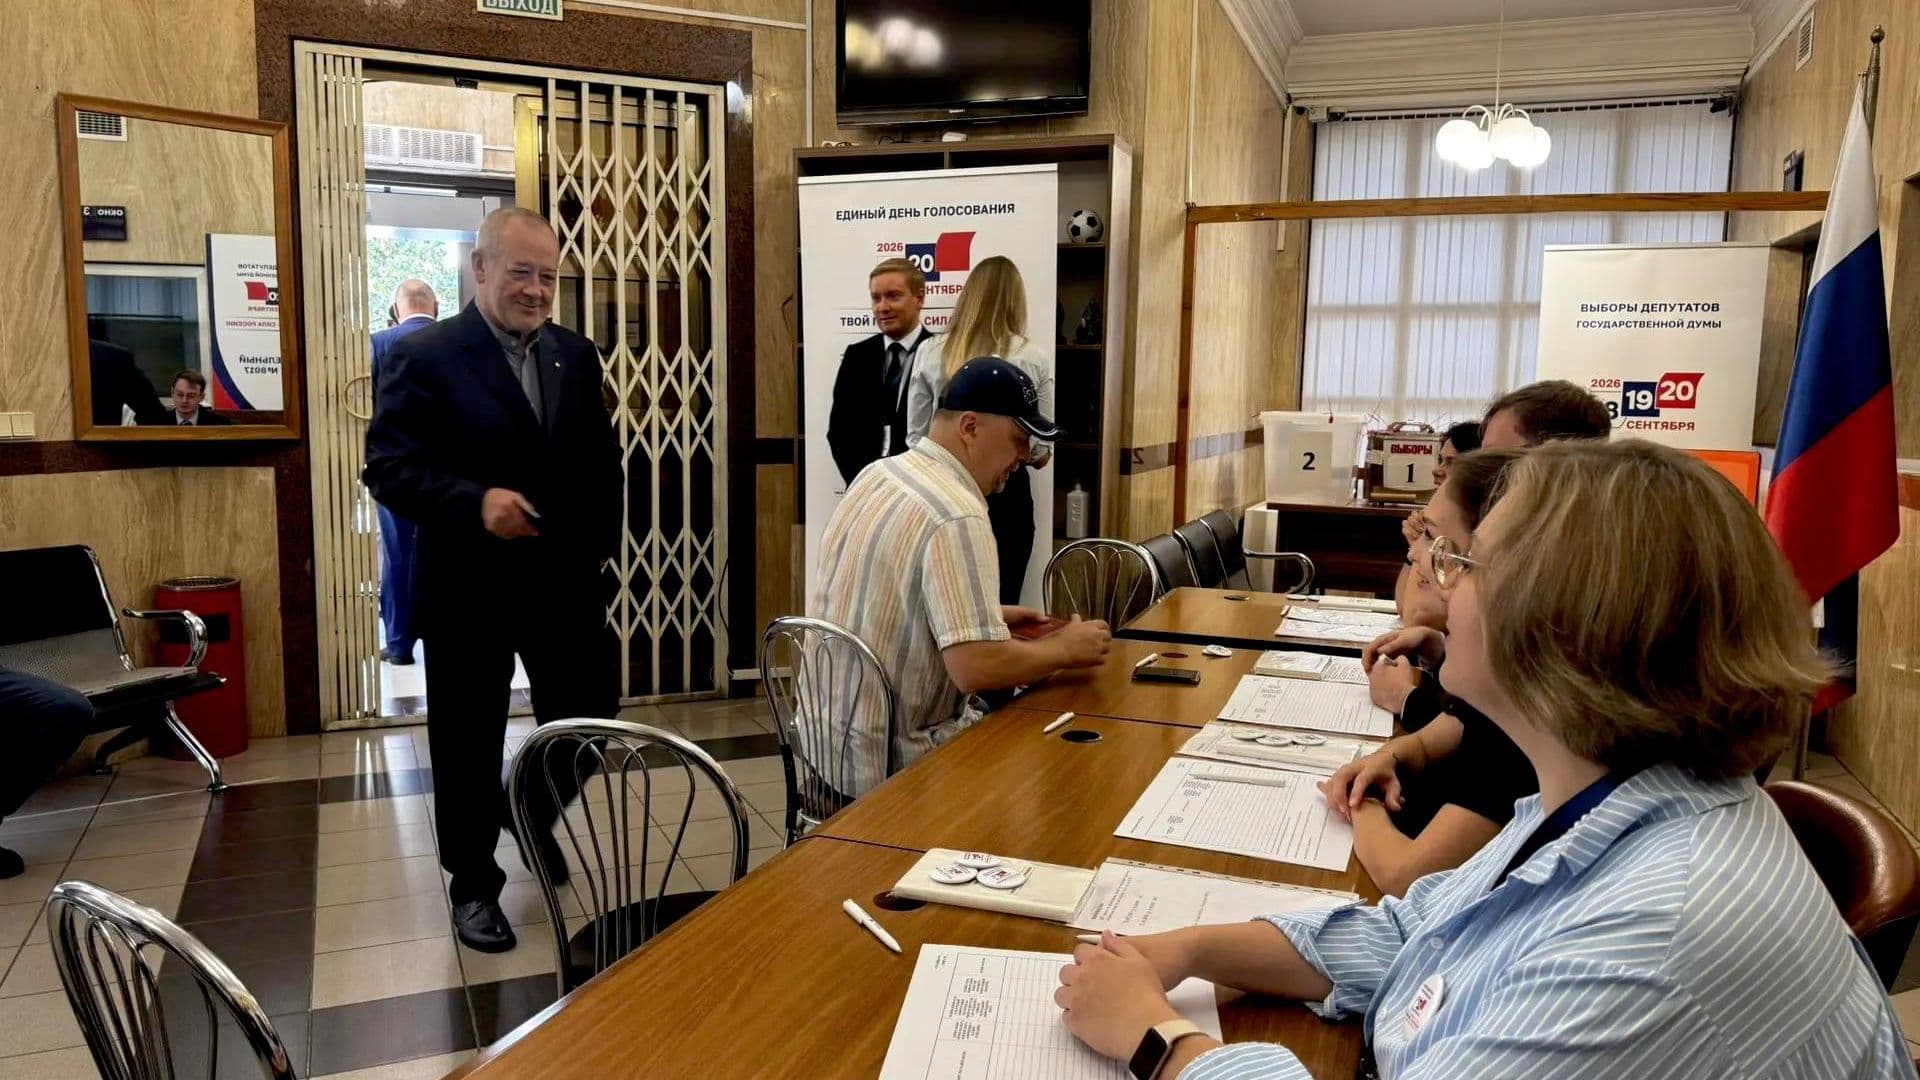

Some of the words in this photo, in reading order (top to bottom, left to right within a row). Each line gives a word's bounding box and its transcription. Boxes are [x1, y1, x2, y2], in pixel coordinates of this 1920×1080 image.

[836, 206, 886, 222] ЕДИНЫЙ
[889, 207, 921, 220] ДЕНЬ
[924, 203, 1015, 218] ГОЛОСОВАНИЯ
[877, 242, 904, 252] 2026
[926, 284, 964, 295] НТЯБР
[1580, 303, 1638, 313] ВЫБОРЫ
[1640, 302, 1720, 314] ДЕПУТАТОВ
[840, 315, 870, 327] ТВОЙ
[1576, 319, 1684, 329] ГОСУДАРСТВЕННОЙ
[1686, 320, 1722, 329] ДУМЫ
[1591, 378, 1621, 388] 2026
[1605, 401, 1619, 420] 8
[1625, 390, 1653, 410] 19
[1659, 380, 1694, 401] 20
[1626, 420, 1695, 431] СЕНТЯБРЯ
[1391, 444, 1432, 455] ВЫБОРЫ
[1302, 452, 1316, 471] 2
[1406, 463, 1415, 483] 1
